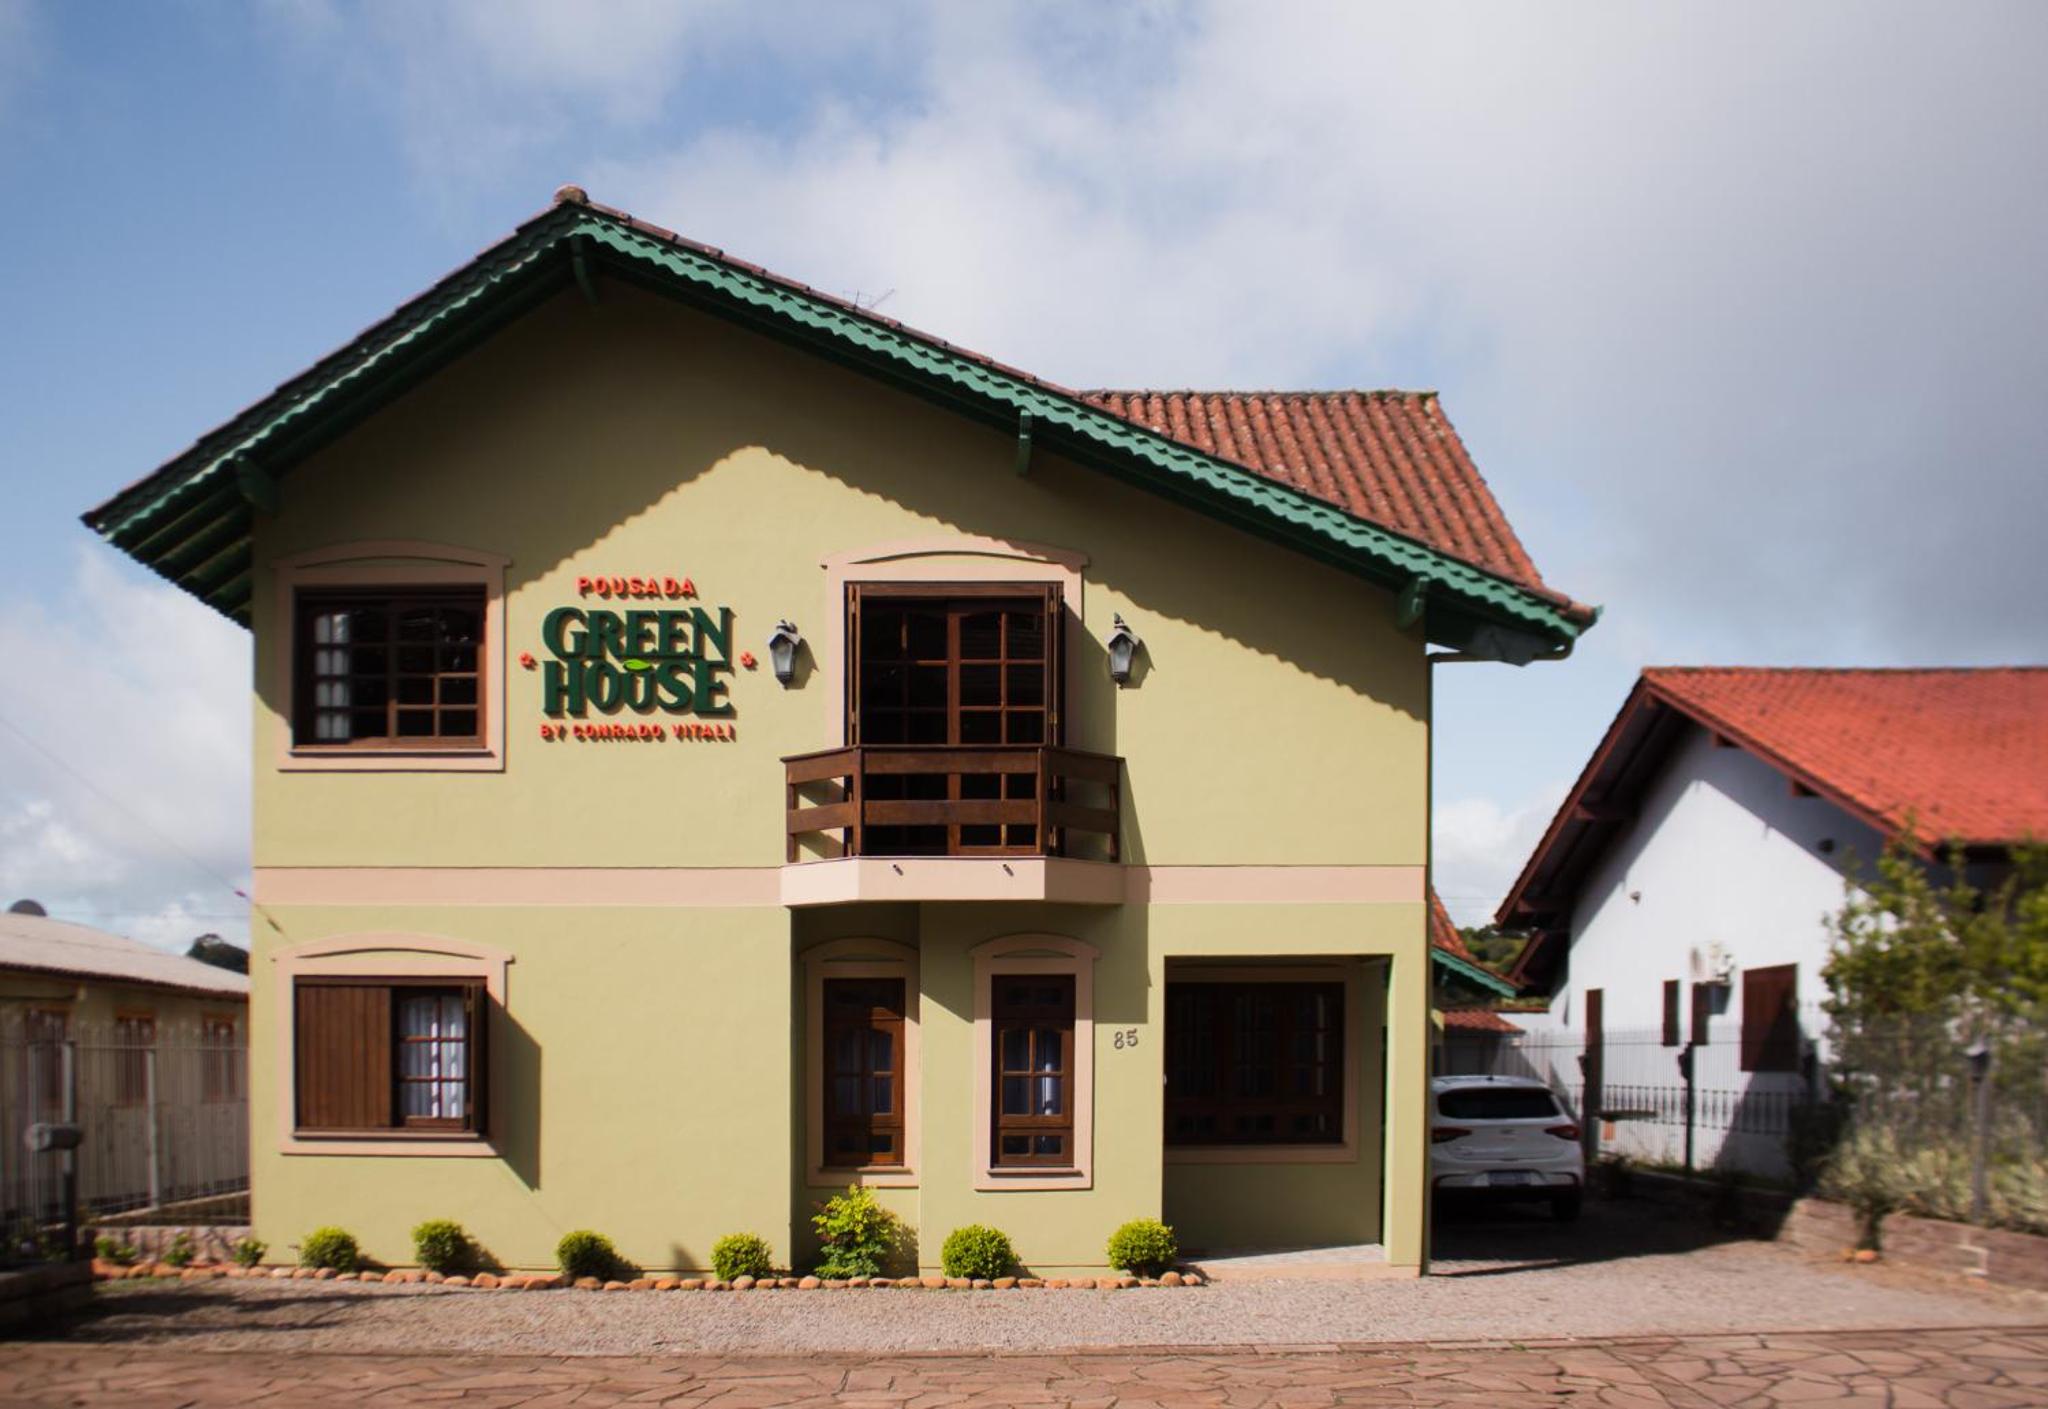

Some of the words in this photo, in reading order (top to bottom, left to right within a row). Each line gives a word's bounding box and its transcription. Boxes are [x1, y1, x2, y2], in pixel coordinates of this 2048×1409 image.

[576, 576, 695, 596] POUSADA
[542, 606, 733, 661] GREEN
[543, 660, 732, 714] HOUSE
[540, 723, 561, 738] BY
[572, 723, 662, 738] CONRADO
[671, 723, 732, 738] VITALI
[1114, 1028, 1138, 1050] 85
